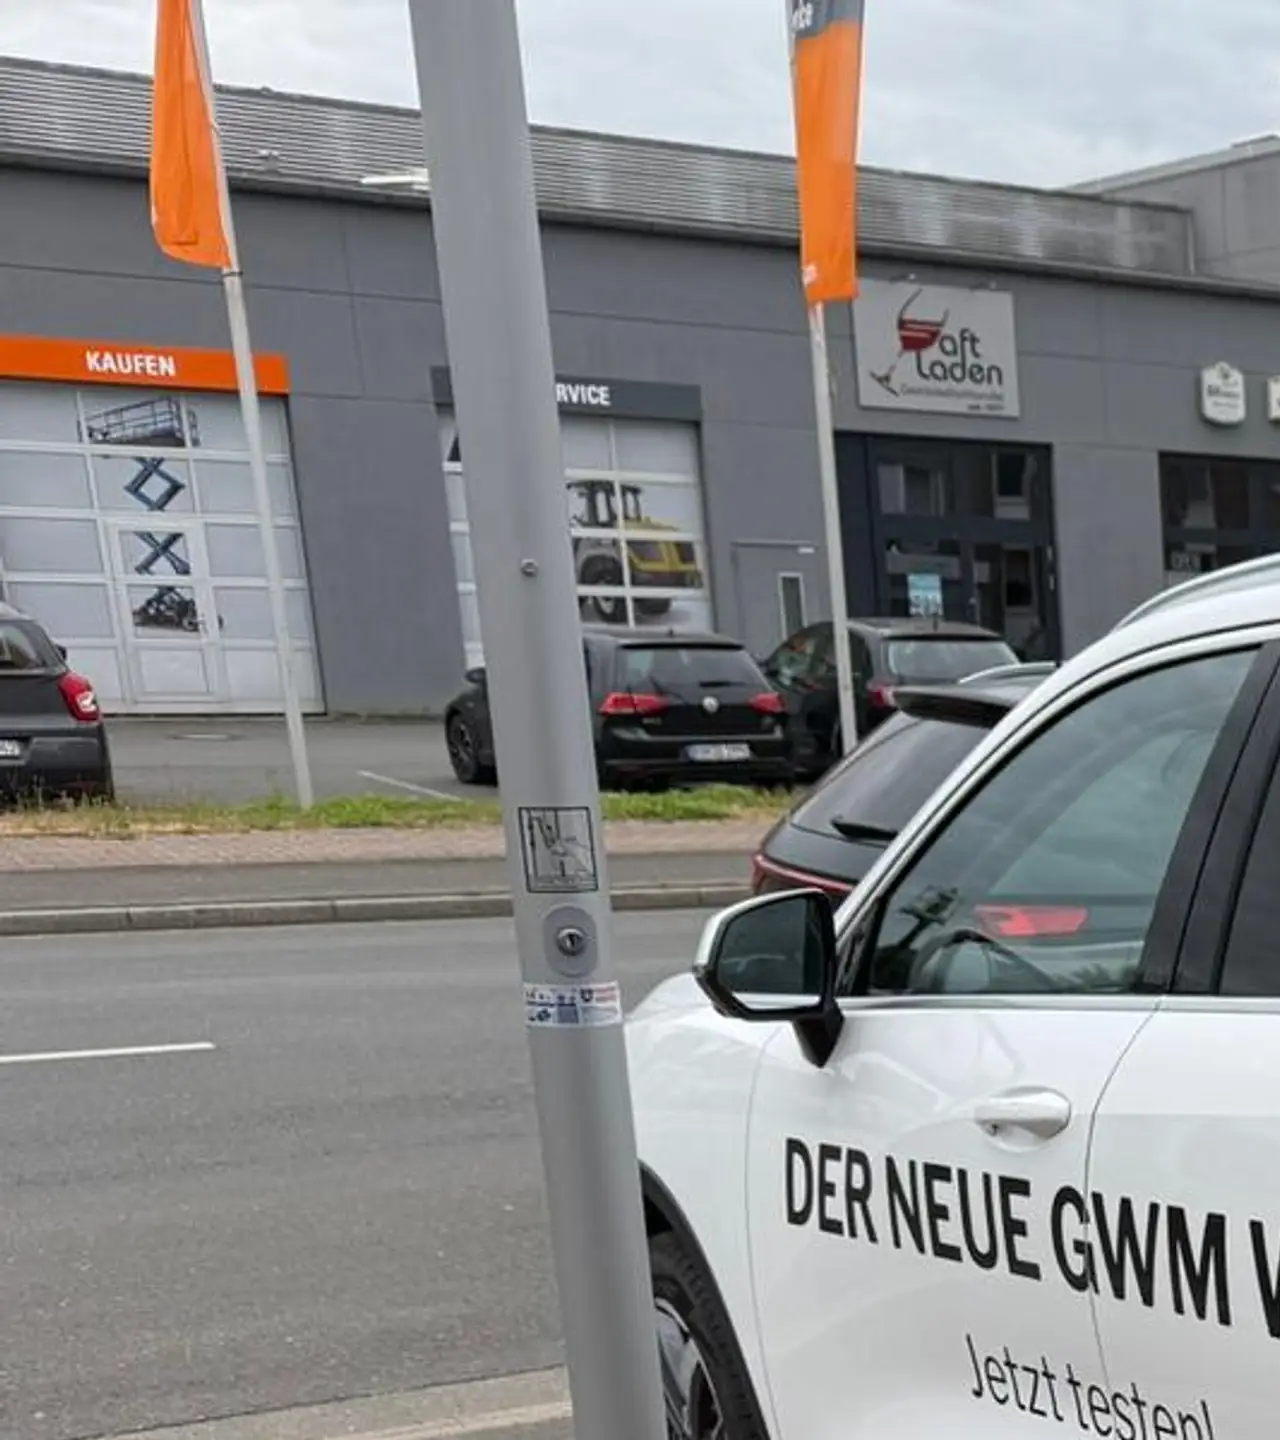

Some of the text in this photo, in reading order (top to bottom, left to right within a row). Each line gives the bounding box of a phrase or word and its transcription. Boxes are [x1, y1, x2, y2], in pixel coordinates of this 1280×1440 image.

[85, 349, 176, 377] KAUFEN
[555, 383, 611, 407] RVICE
[786, 1137, 879, 1245] DER
[885, 1155, 1042, 1282] NEUE
[1050, 1184, 1232, 1327] GWM
[966, 1333, 1065, 1423] Jetzt
